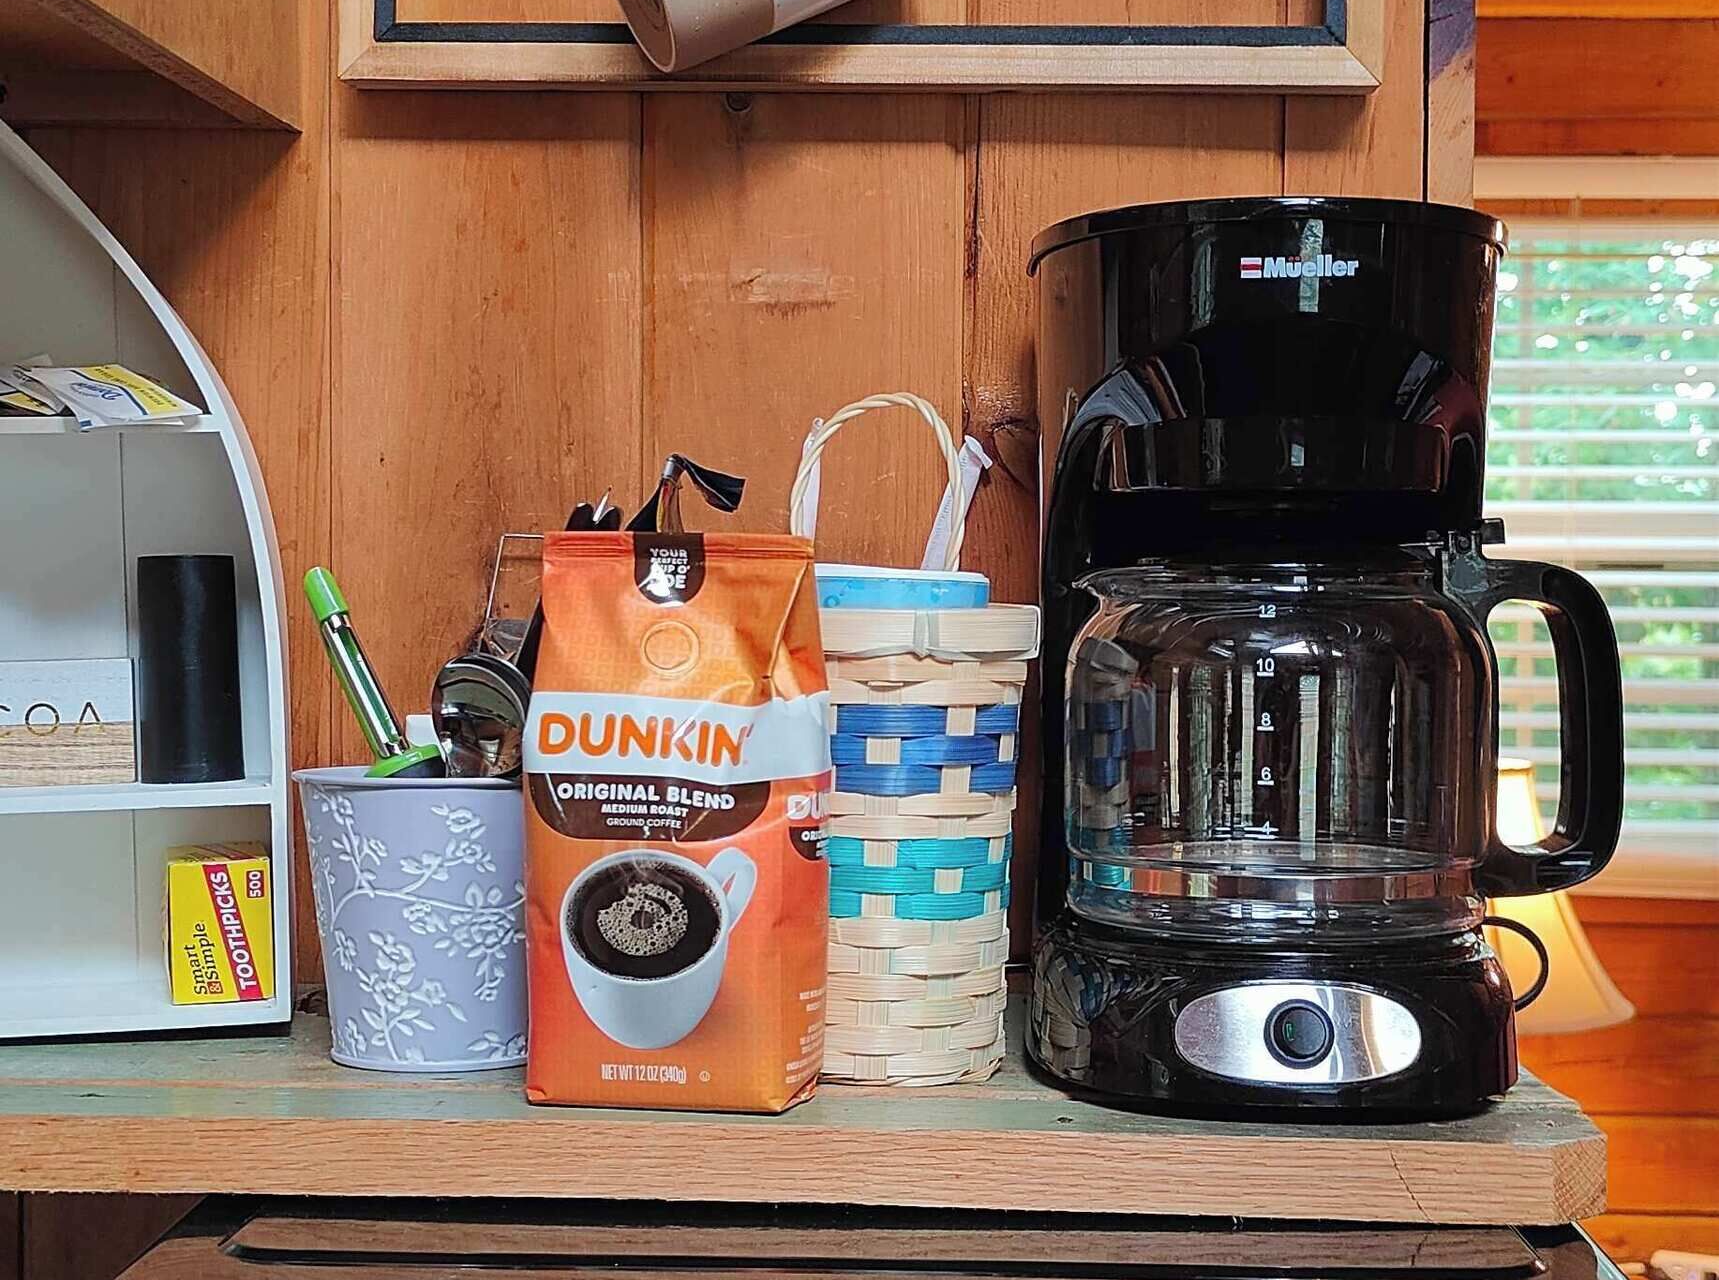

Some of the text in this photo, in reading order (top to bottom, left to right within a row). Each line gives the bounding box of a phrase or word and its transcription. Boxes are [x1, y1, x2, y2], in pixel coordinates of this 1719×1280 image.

[650, 548, 688, 558] YOUR
[1258, 604, 1276, 615] 12
[1256, 658, 1275, 672] 10
[0, 701, 105, 738] OA
[1261, 712, 1271, 726] 8
[1261, 767, 1271, 781] 6
[557, 783, 736, 810] ORIGINAL BLEND
[601, 804, 689, 817] MEDIUM ROAST
[606, 817, 682, 829] GROUND COFFEE
[1261, 821, 1270, 835] 4
[248, 871, 261, 897] 500
[210, 871, 257, 990] TOOTHPICKS
[184, 944, 209, 994] Smart
[601, 1064, 617, 1080] NET
[618, 1064, 634, 1081] WT
[635, 1065, 646, 1081] 12
